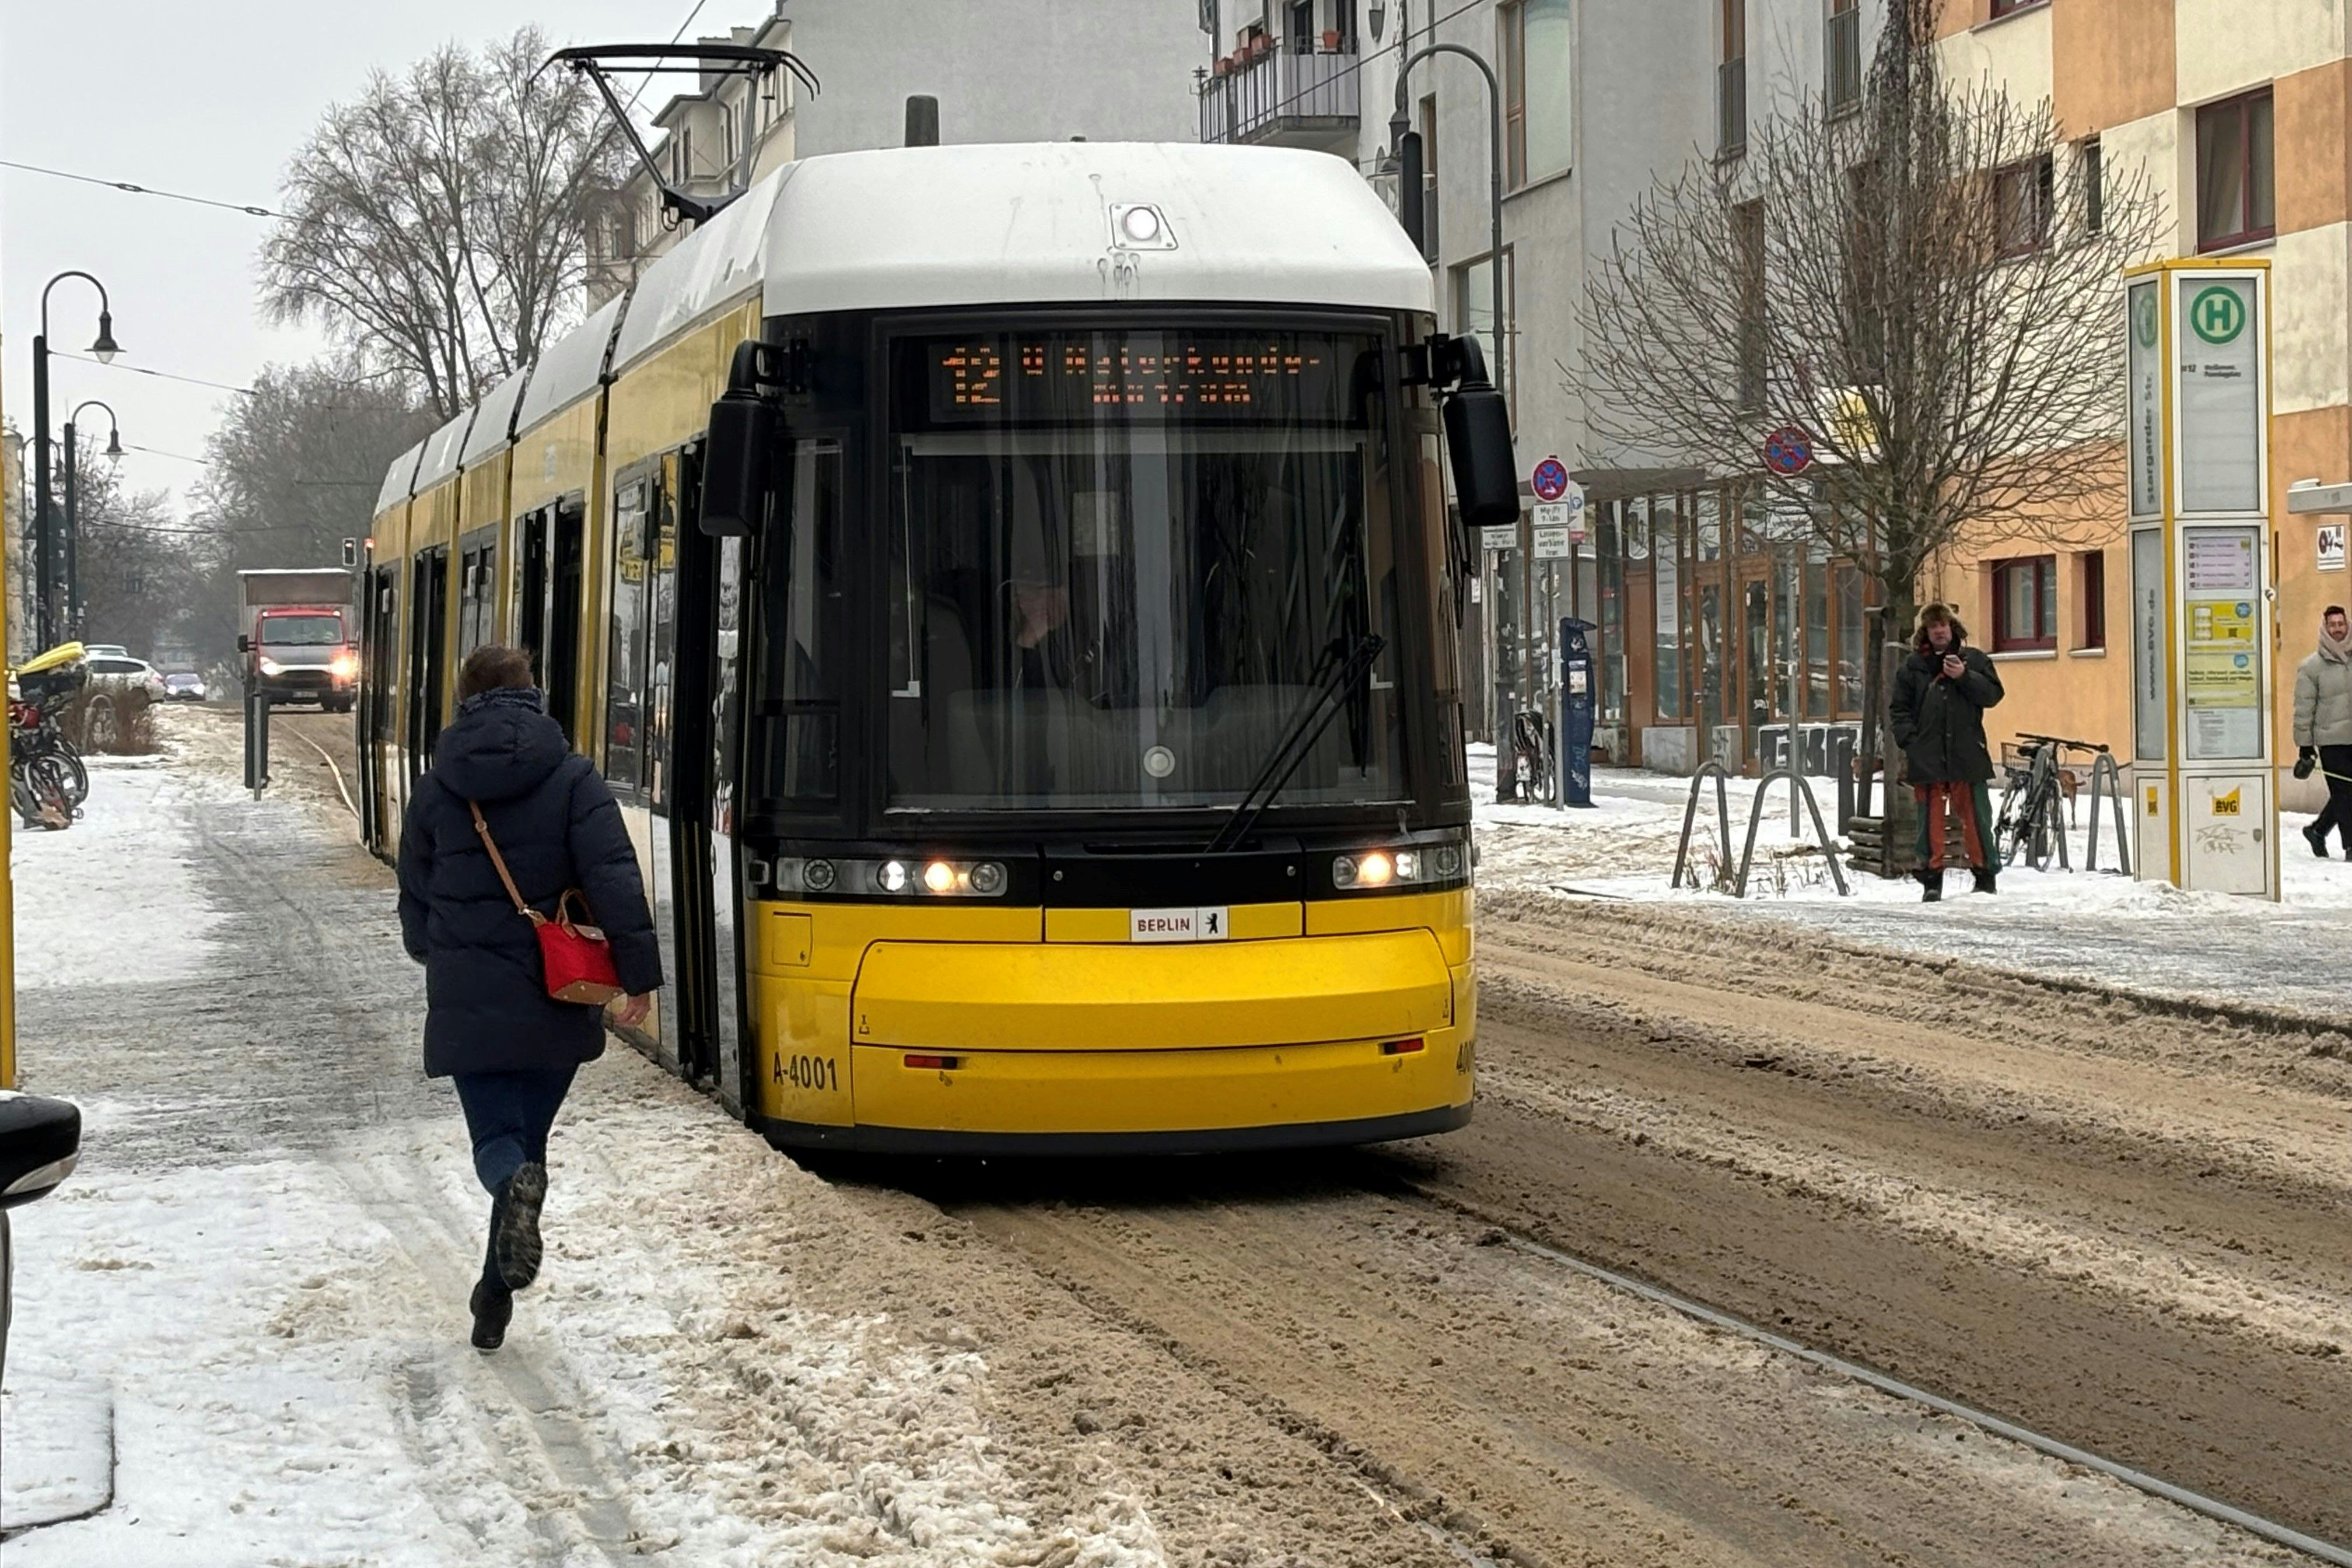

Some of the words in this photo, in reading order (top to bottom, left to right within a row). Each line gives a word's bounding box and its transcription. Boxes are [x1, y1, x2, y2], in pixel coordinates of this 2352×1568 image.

[2206, 299, 2231, 331] H
[942, 347, 1000, 404] 12
[1138, 917, 1191, 932] BERLIN
[773, 1051, 838, 1091] A-4001
